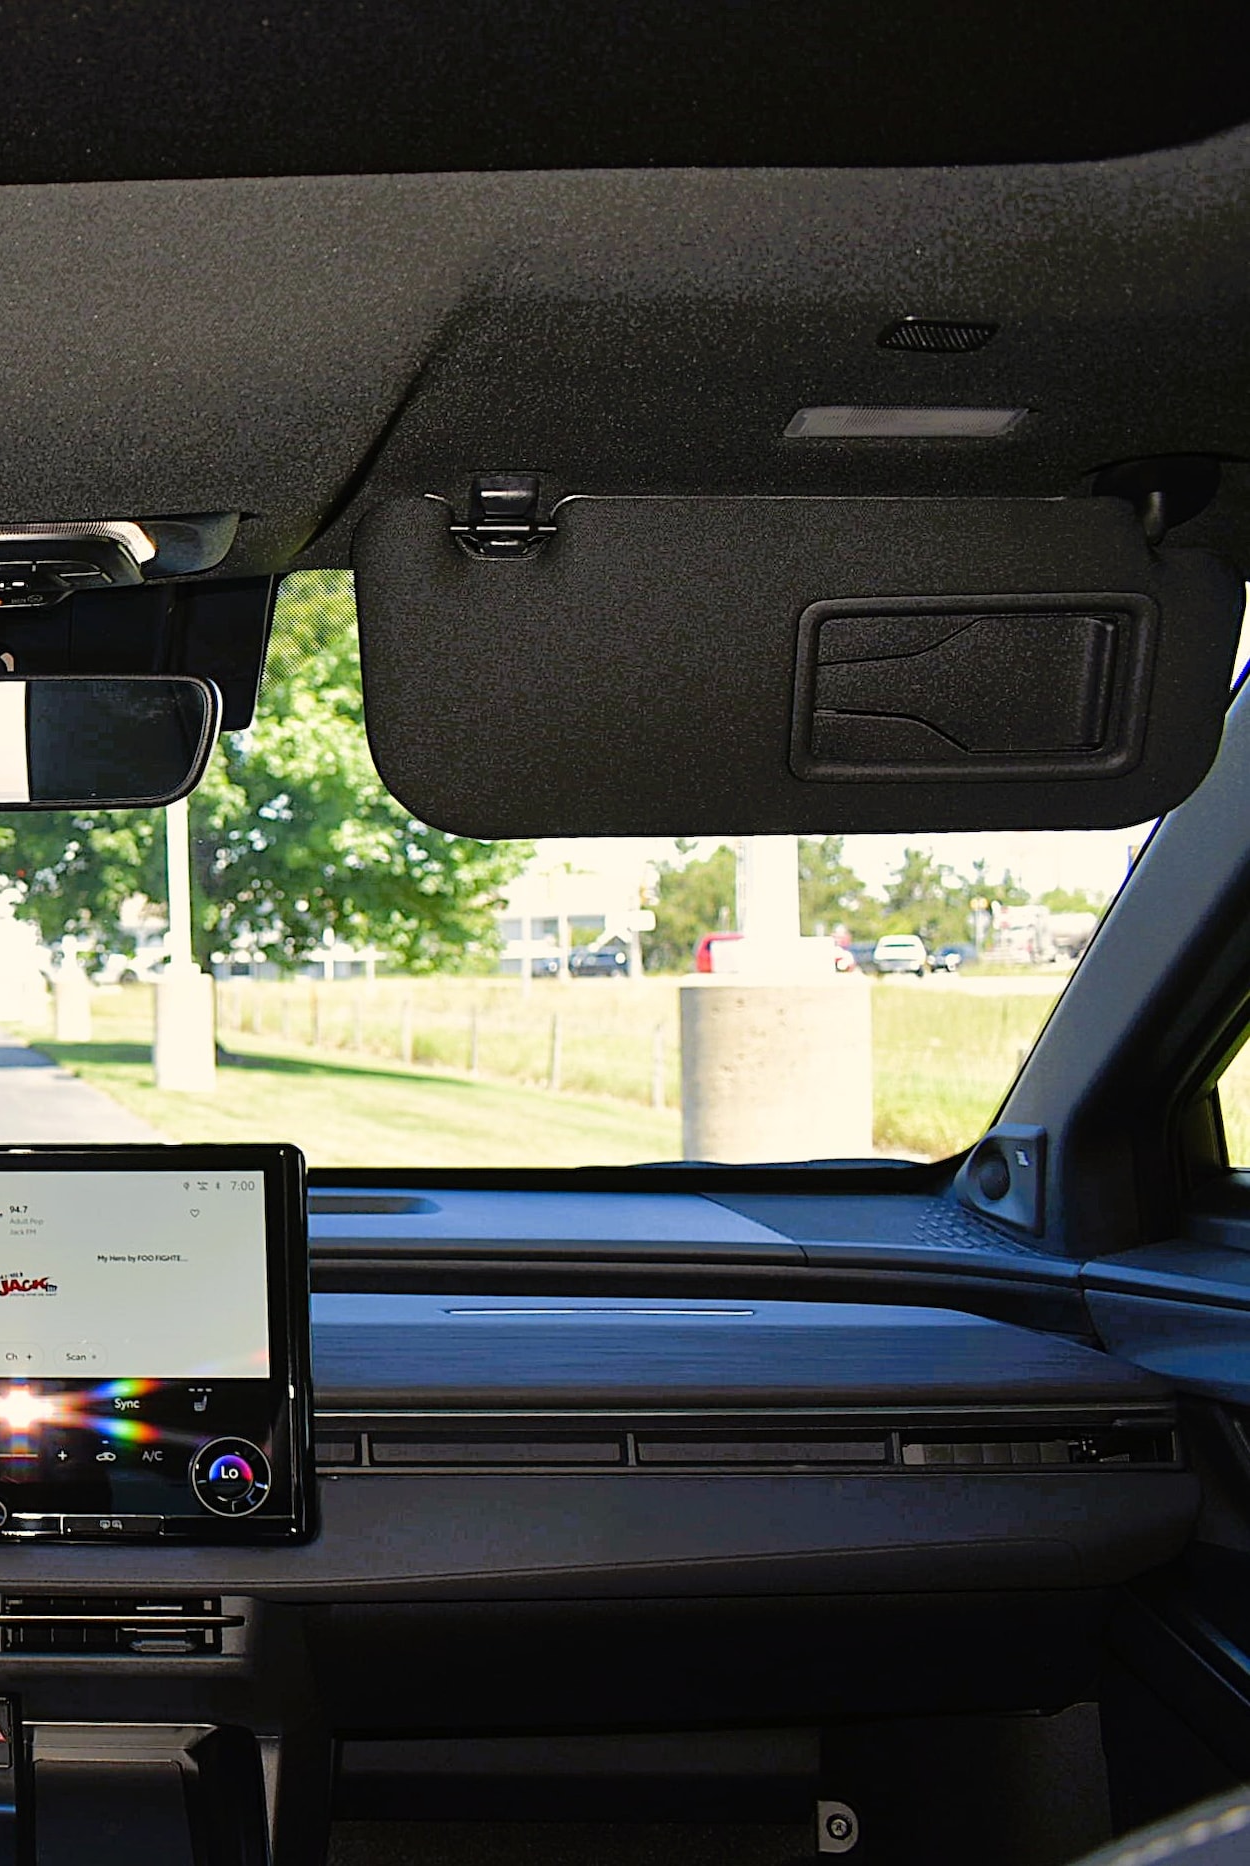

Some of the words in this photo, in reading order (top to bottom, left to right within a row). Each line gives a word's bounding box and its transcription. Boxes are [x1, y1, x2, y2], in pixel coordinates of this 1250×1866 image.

[230, 1181, 255, 1190] 7:00
[66, 1352, 86, 1360] Scan
[114, 1398, 140, 1410] Sync
[142, 1451, 163, 1462] A/C
[221, 1466, 239, 1479] Lo
